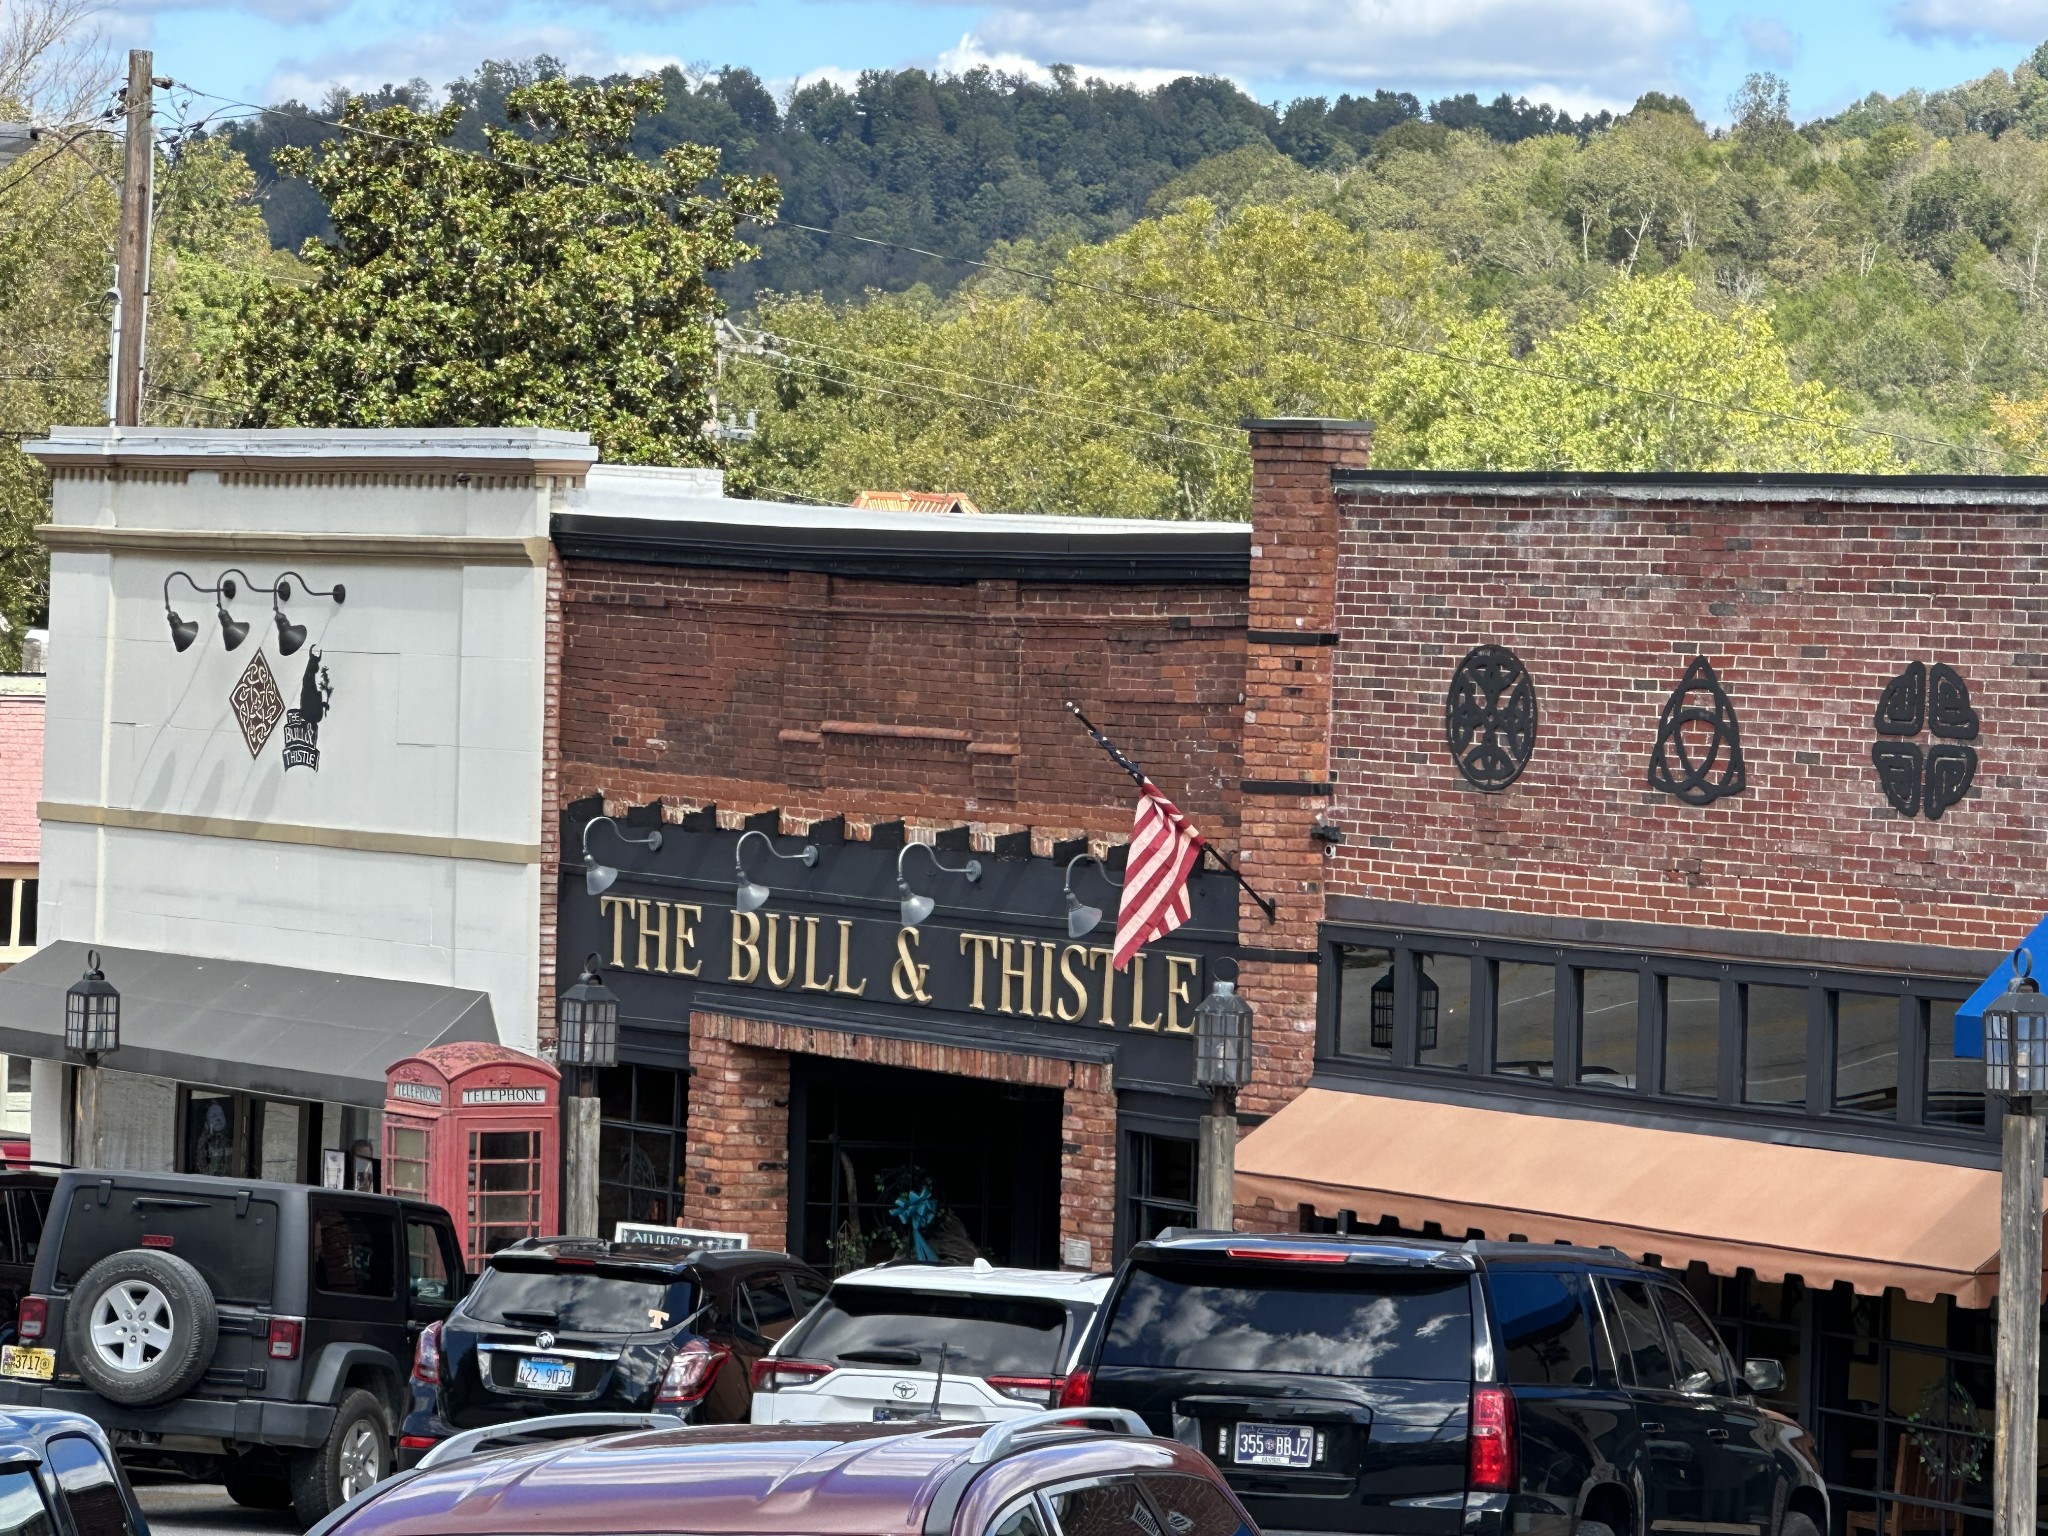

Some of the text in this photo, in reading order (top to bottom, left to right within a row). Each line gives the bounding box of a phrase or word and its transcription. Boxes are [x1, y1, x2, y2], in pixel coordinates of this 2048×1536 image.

[288, 712, 300, 723] THE
[285, 726, 305, 744] BULL
[283, 750, 316, 766] THISTLE
[601, 896, 1197, 1035] THE BULL & THISTLE
[396, 1083, 441, 1101] TELEPHONE
[467, 1088, 542, 1102] TELEPHONE
[546, 1368, 571, 1385] 9033
[1239, 1434, 1309, 1457] 355 BBJZ
